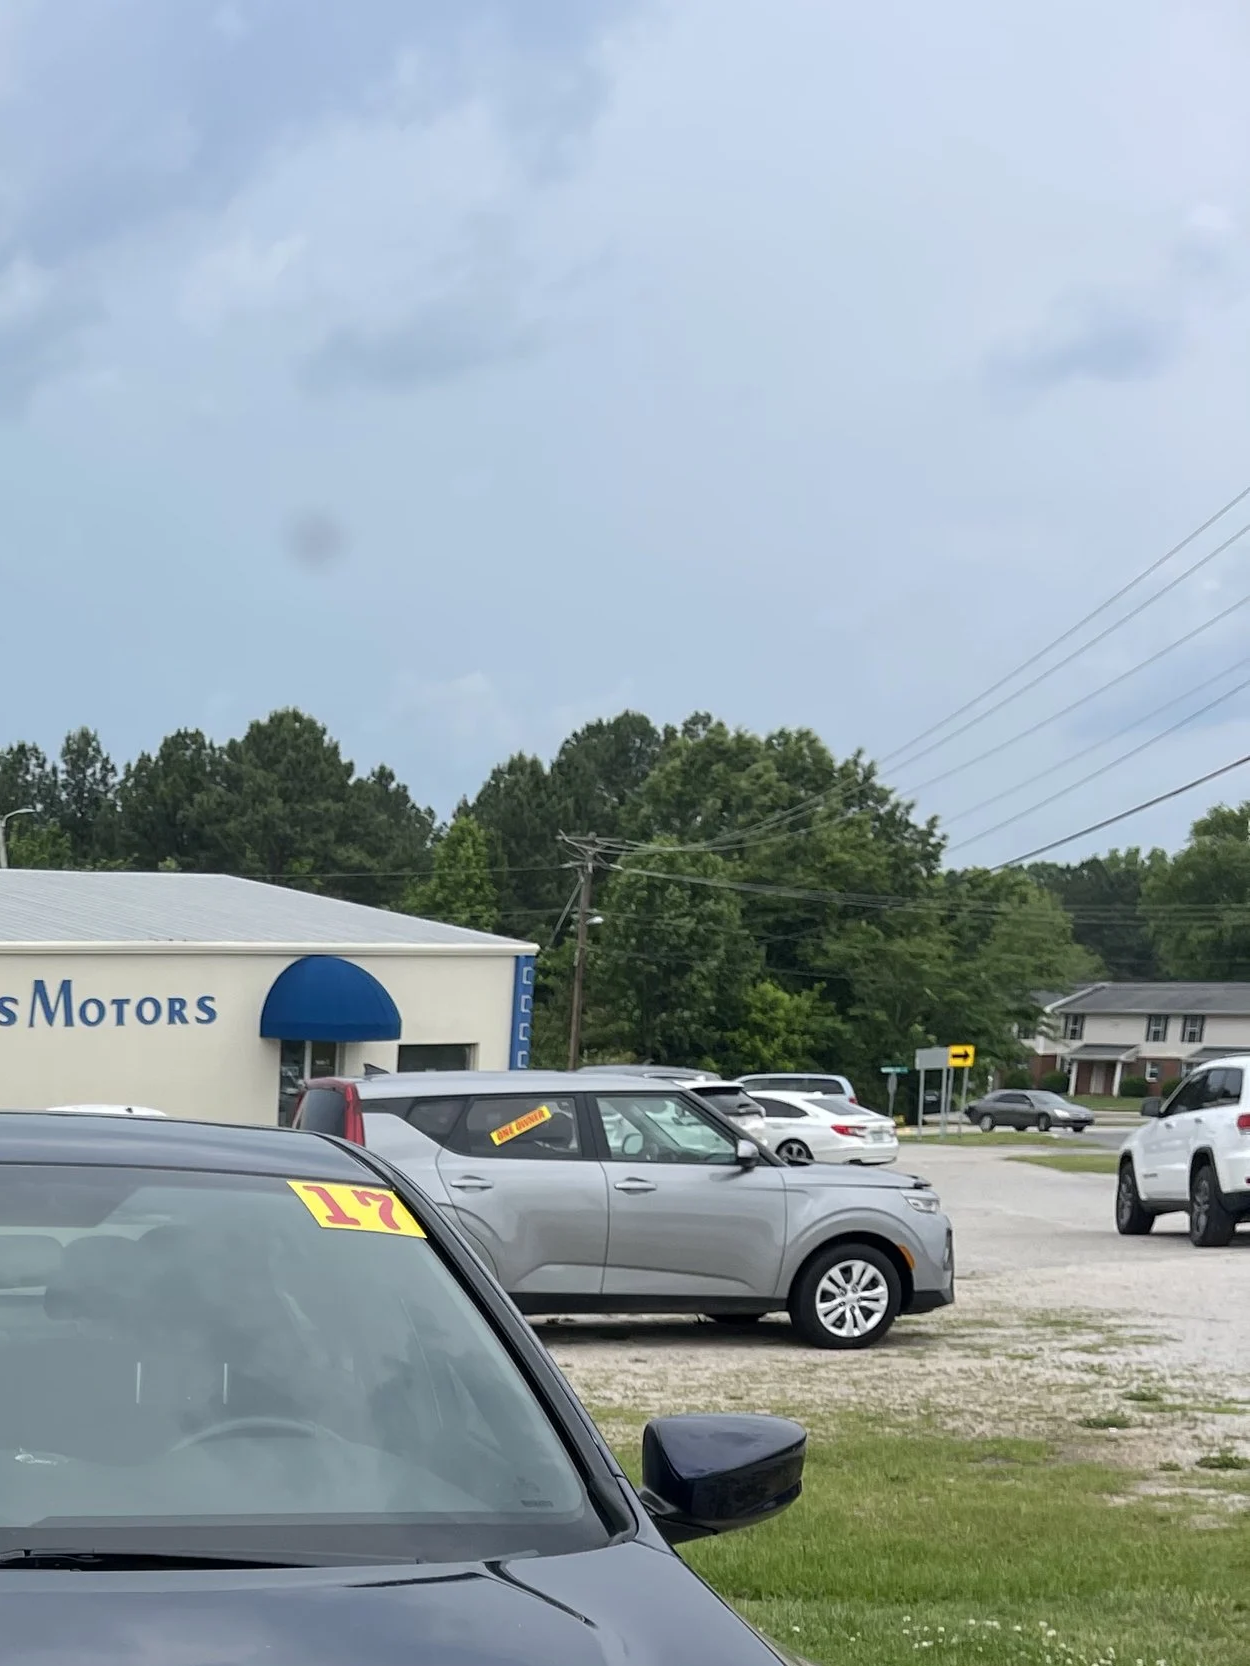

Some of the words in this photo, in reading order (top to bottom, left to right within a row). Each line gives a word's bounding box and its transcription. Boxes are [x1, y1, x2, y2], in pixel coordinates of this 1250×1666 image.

[28, 979, 218, 1028] MOTORS
[515, 1109, 546, 1131] OWNER
[301, 1184, 402, 1231] 17
